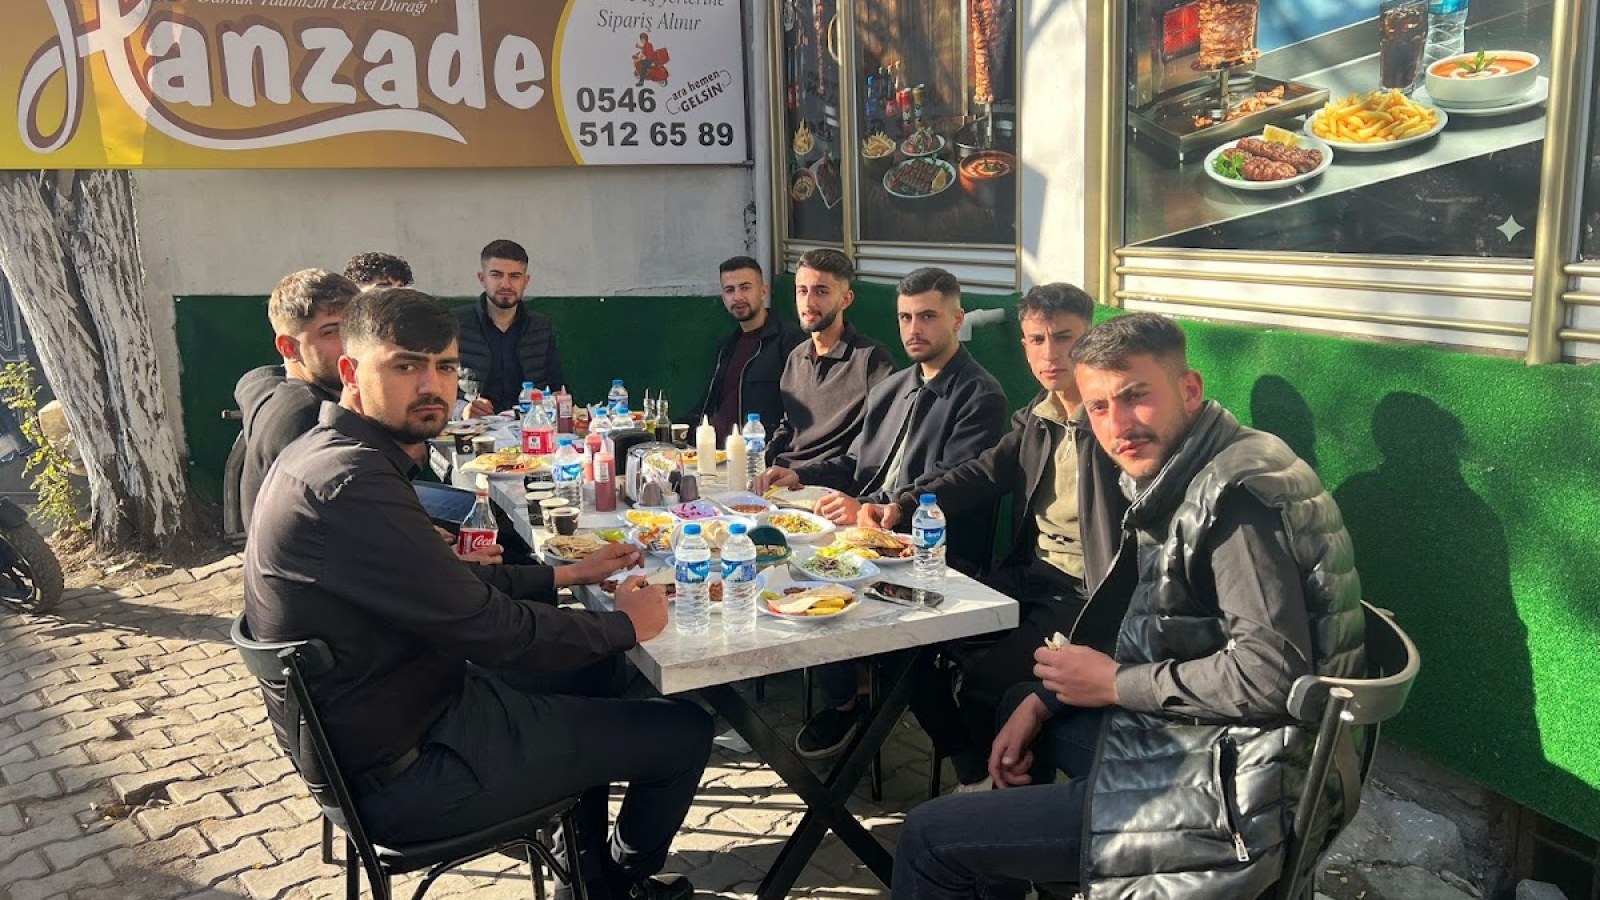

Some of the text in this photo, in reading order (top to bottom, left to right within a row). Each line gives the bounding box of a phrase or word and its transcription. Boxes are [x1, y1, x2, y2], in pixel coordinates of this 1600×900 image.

[597, 9, 702, 32] Sipariş Alınır
[18, 0, 546, 154] Hanzade
[672, 71, 720, 101] ara hemen
[577, 87, 656, 113] 0546
[680, 82, 724, 112] GELSİN
[579, 121, 734, 147] 512 65 89
